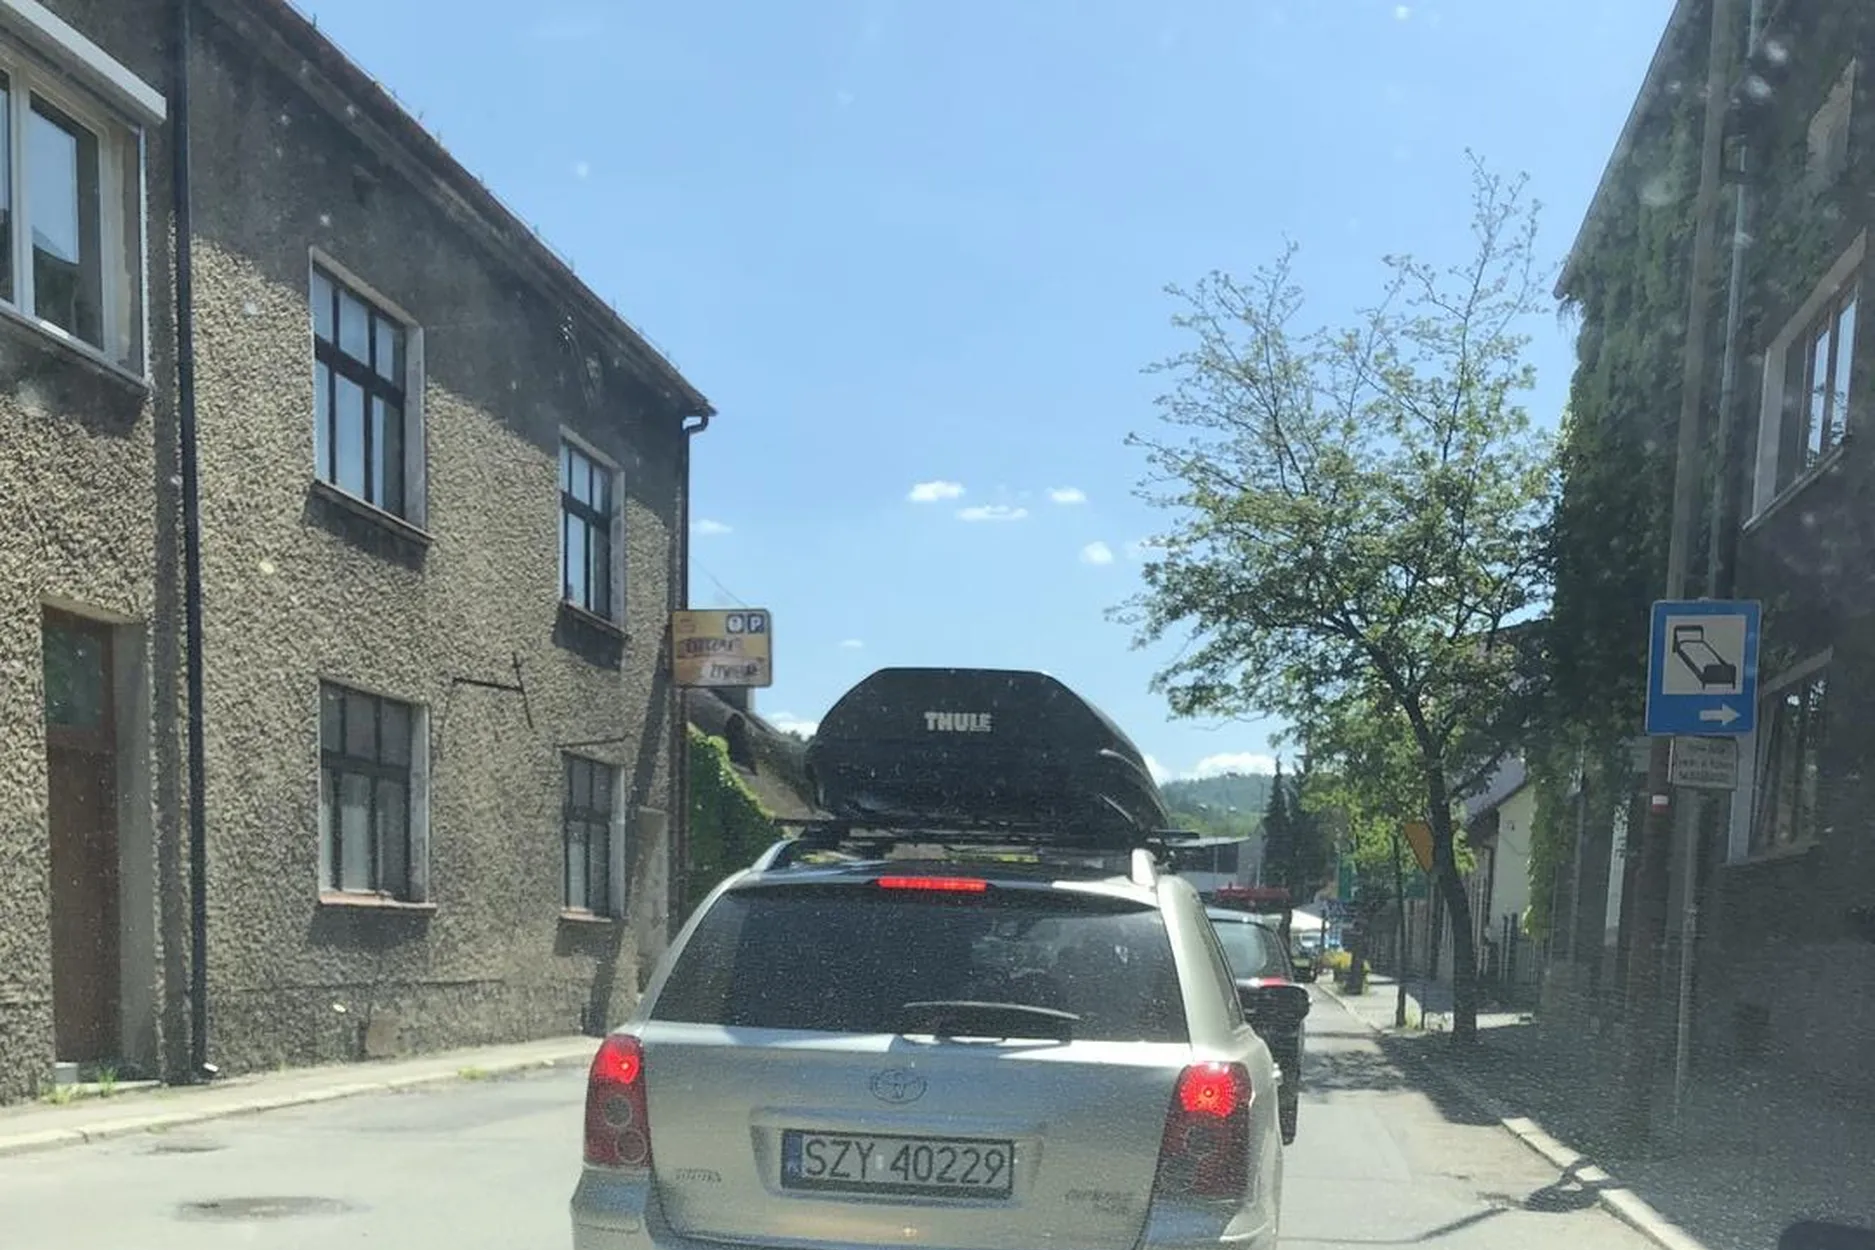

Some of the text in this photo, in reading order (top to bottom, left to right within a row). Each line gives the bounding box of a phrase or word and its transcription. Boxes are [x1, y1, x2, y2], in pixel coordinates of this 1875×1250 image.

[924, 712, 992, 732] THULE
[805, 1138, 875, 1179] SZY
[890, 1144, 1006, 1185] 40229
